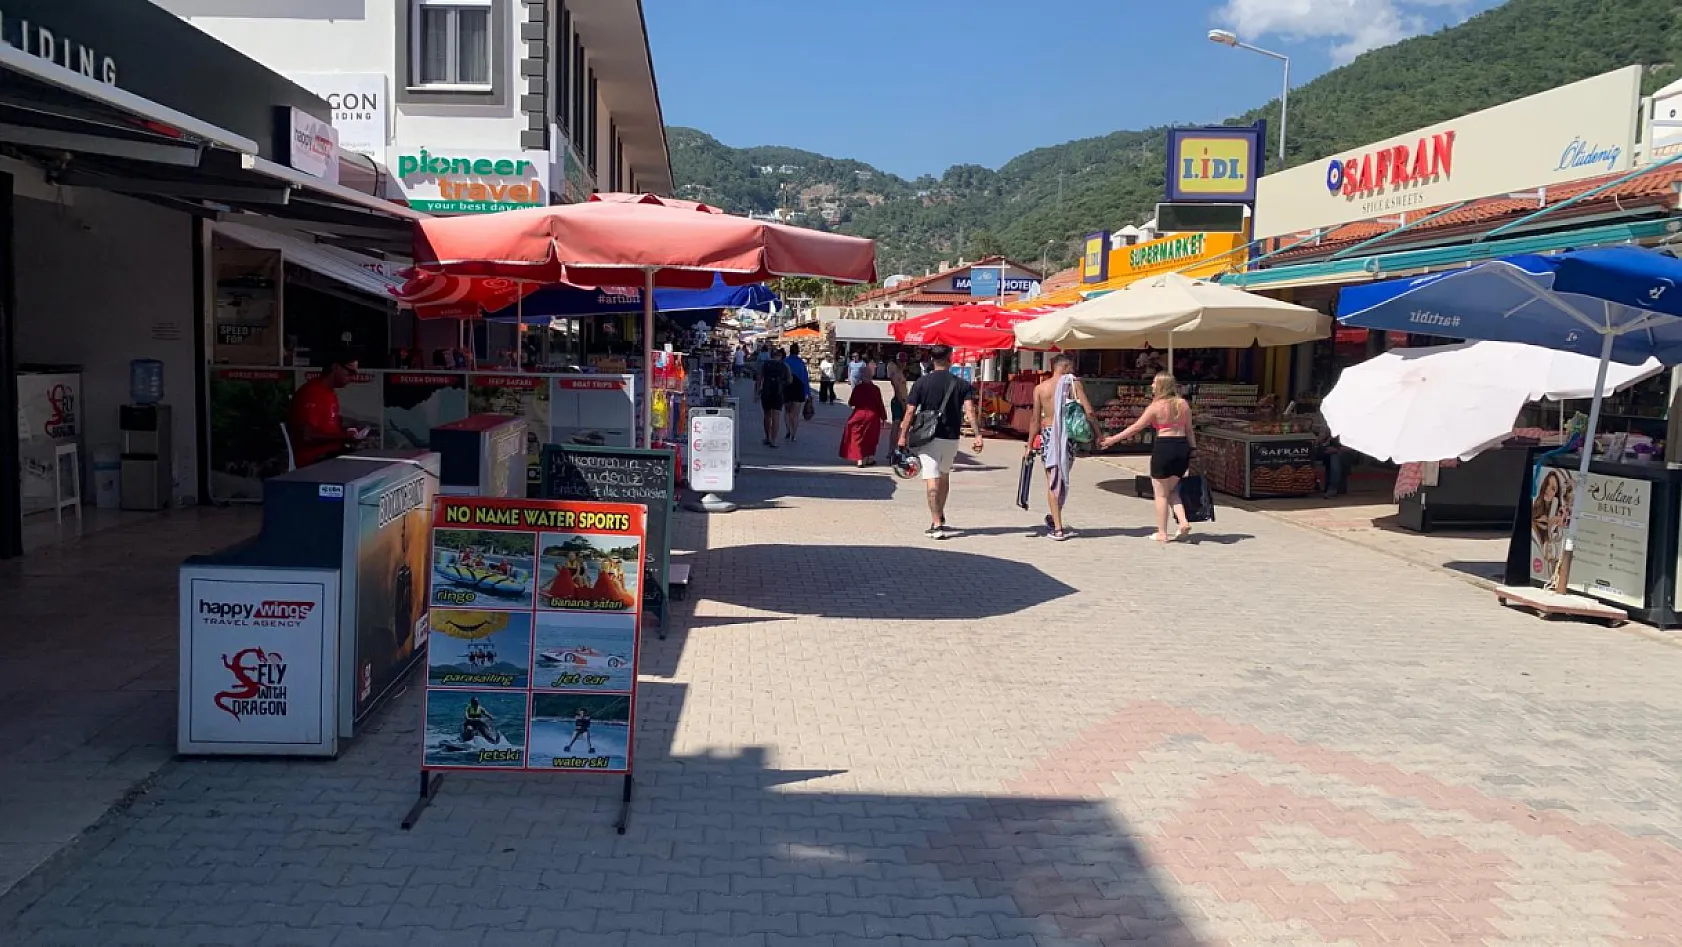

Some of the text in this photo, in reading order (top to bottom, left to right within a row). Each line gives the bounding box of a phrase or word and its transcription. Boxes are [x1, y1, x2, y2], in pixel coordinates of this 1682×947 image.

[327, 93, 377, 110] GON
[398, 148, 533, 179] pioneer
[1343, 131, 1456, 195] SAFRAN
[438, 178, 540, 202] travel
[427, 202, 456, 213] your
[459, 200, 488, 212] best
[490, 202, 513, 214] day
[1129, 232, 1205, 267] SUPERMARKET
[1261, 446, 1310, 456] SAFRAN
[1592, 481, 1641, 506] Sultan's
[446, 505, 630, 530] NO NAME WATER SPORTS
[1597, 502, 1633, 517] BEAUTY
[437, 589, 476, 603] ringo
[550, 597, 623, 610] banana safari
[198, 598, 313, 621] happy wings
[202, 617, 302, 628] TRAVEL AGENCY
[257, 663, 288, 685] FLY
[441, 673, 515, 687] parasailing
[551, 671, 609, 688] jet car
[232, 699, 288, 717] DRAGON
[477, 748, 521, 764] jetski
[552, 756, 609, 769] water ski
